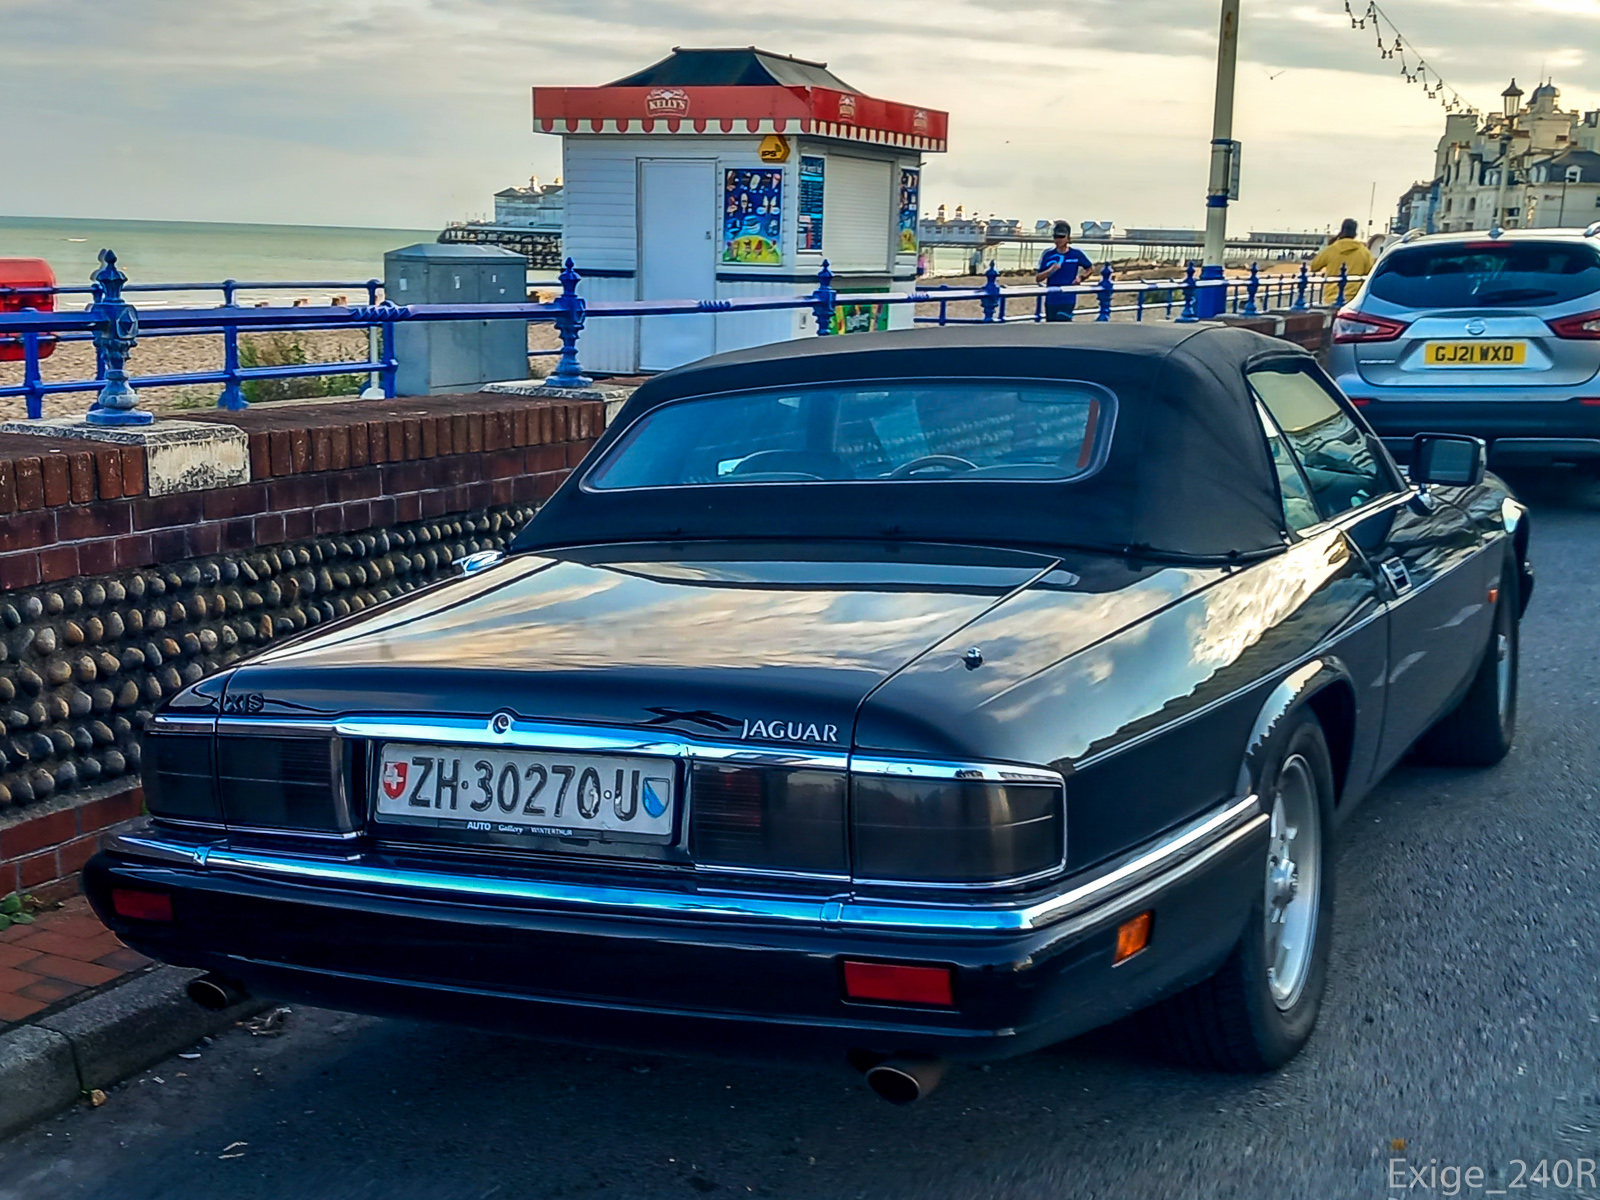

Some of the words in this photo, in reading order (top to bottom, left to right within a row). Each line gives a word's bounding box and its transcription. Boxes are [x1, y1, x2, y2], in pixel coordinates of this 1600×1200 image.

[648, 99, 686, 110] KELLY'S
[1435, 345, 1474, 362] GJ21
[1480, 345, 1514, 362] WXD
[739, 718, 839, 743] JAGUAR
[467, 821, 491, 831] AUTO
[498, 824, 524, 835] Gallery
[531, 827, 573, 836] WINTERTHUR
